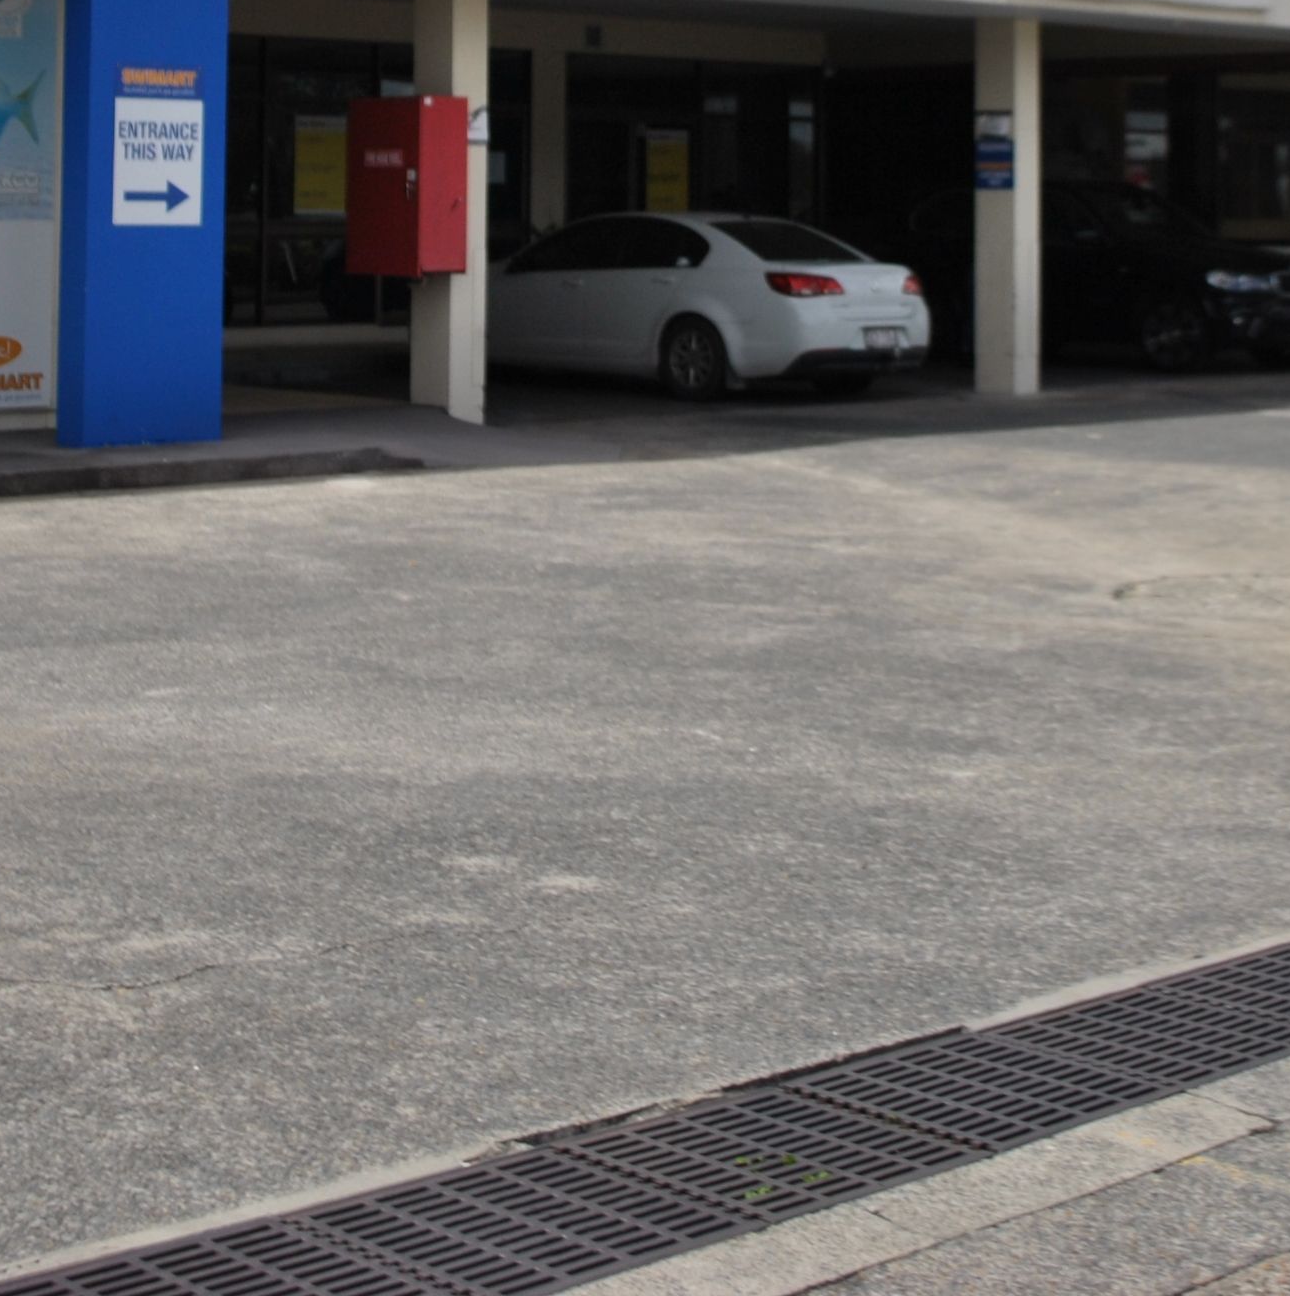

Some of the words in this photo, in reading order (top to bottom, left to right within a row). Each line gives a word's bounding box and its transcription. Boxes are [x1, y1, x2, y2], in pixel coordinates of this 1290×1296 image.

[121, 67, 198, 88] SWIMART
[118, 120, 199, 140] ENTRANCE
[122, 141, 157, 161] THIS
[161, 142, 195, 162] WAY
